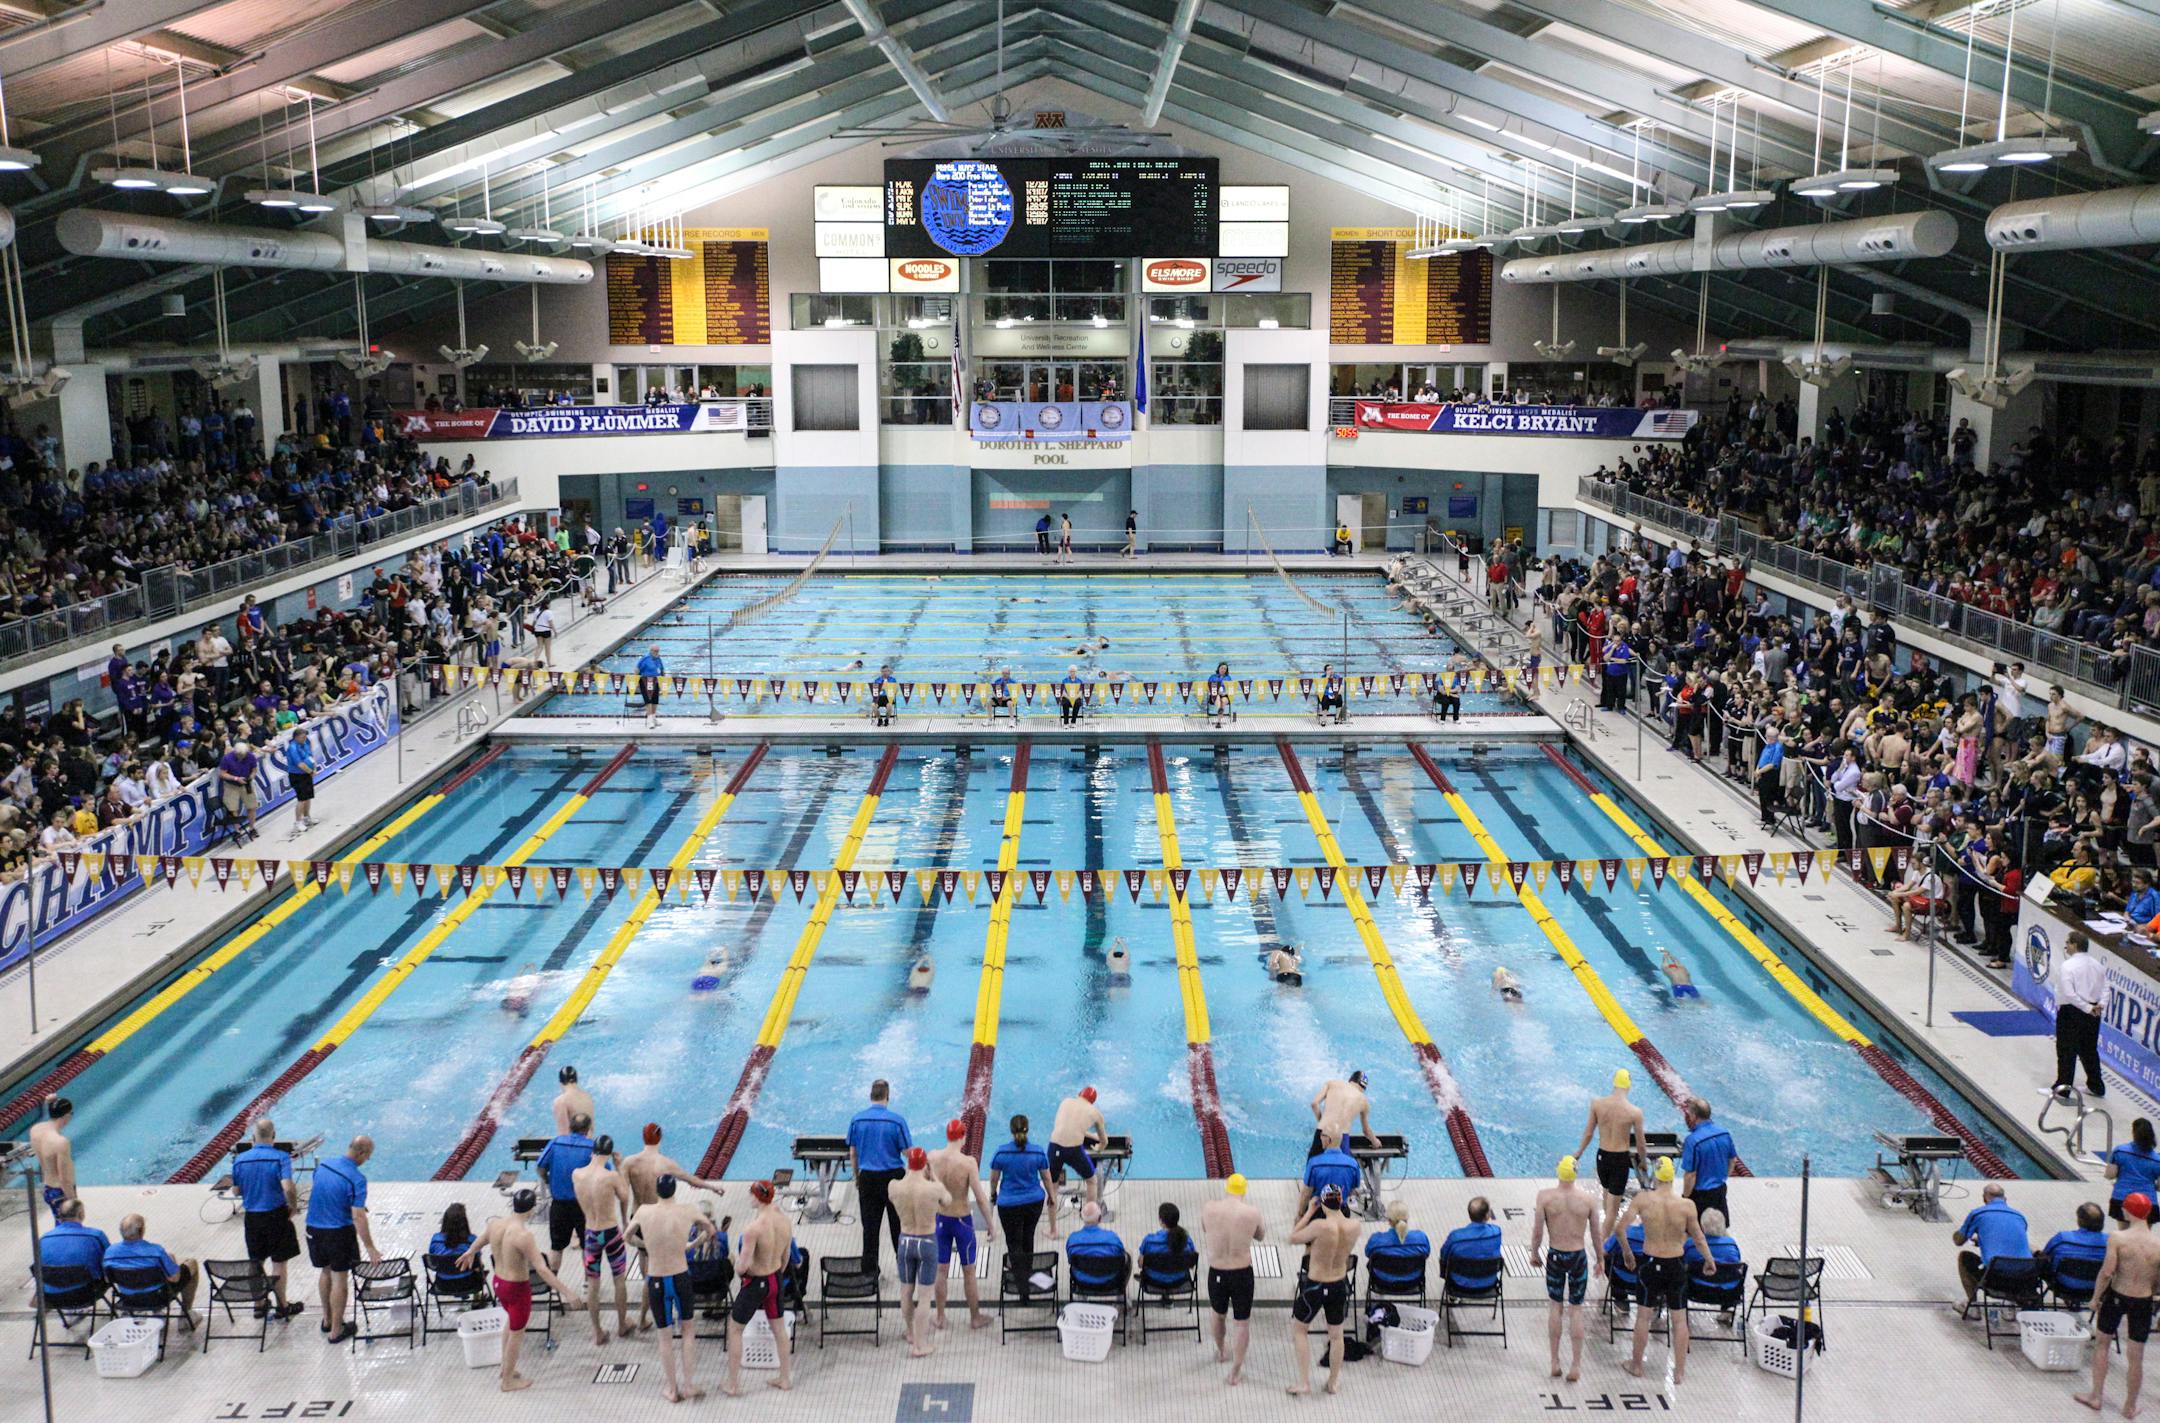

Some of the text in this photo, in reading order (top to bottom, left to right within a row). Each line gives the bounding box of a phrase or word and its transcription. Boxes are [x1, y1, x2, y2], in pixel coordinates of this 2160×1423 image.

[905, 263, 945, 273] NOODLES
[1151, 268, 1202, 277] ELSMORE
[1217, 260, 1277, 277] speedo
[1541, 408, 1577, 416] MEDALIST
[511, 414, 680, 433] DAVID PLUMMER
[1453, 413, 1597, 432] KELCI BRYANT
[979, 440, 1040, 450] DOROTHY
[1058, 440, 1123, 450] SHEPPARD
[1033, 454, 1068, 465] POOL
[2107, 1039, 2141, 1074] STATE
